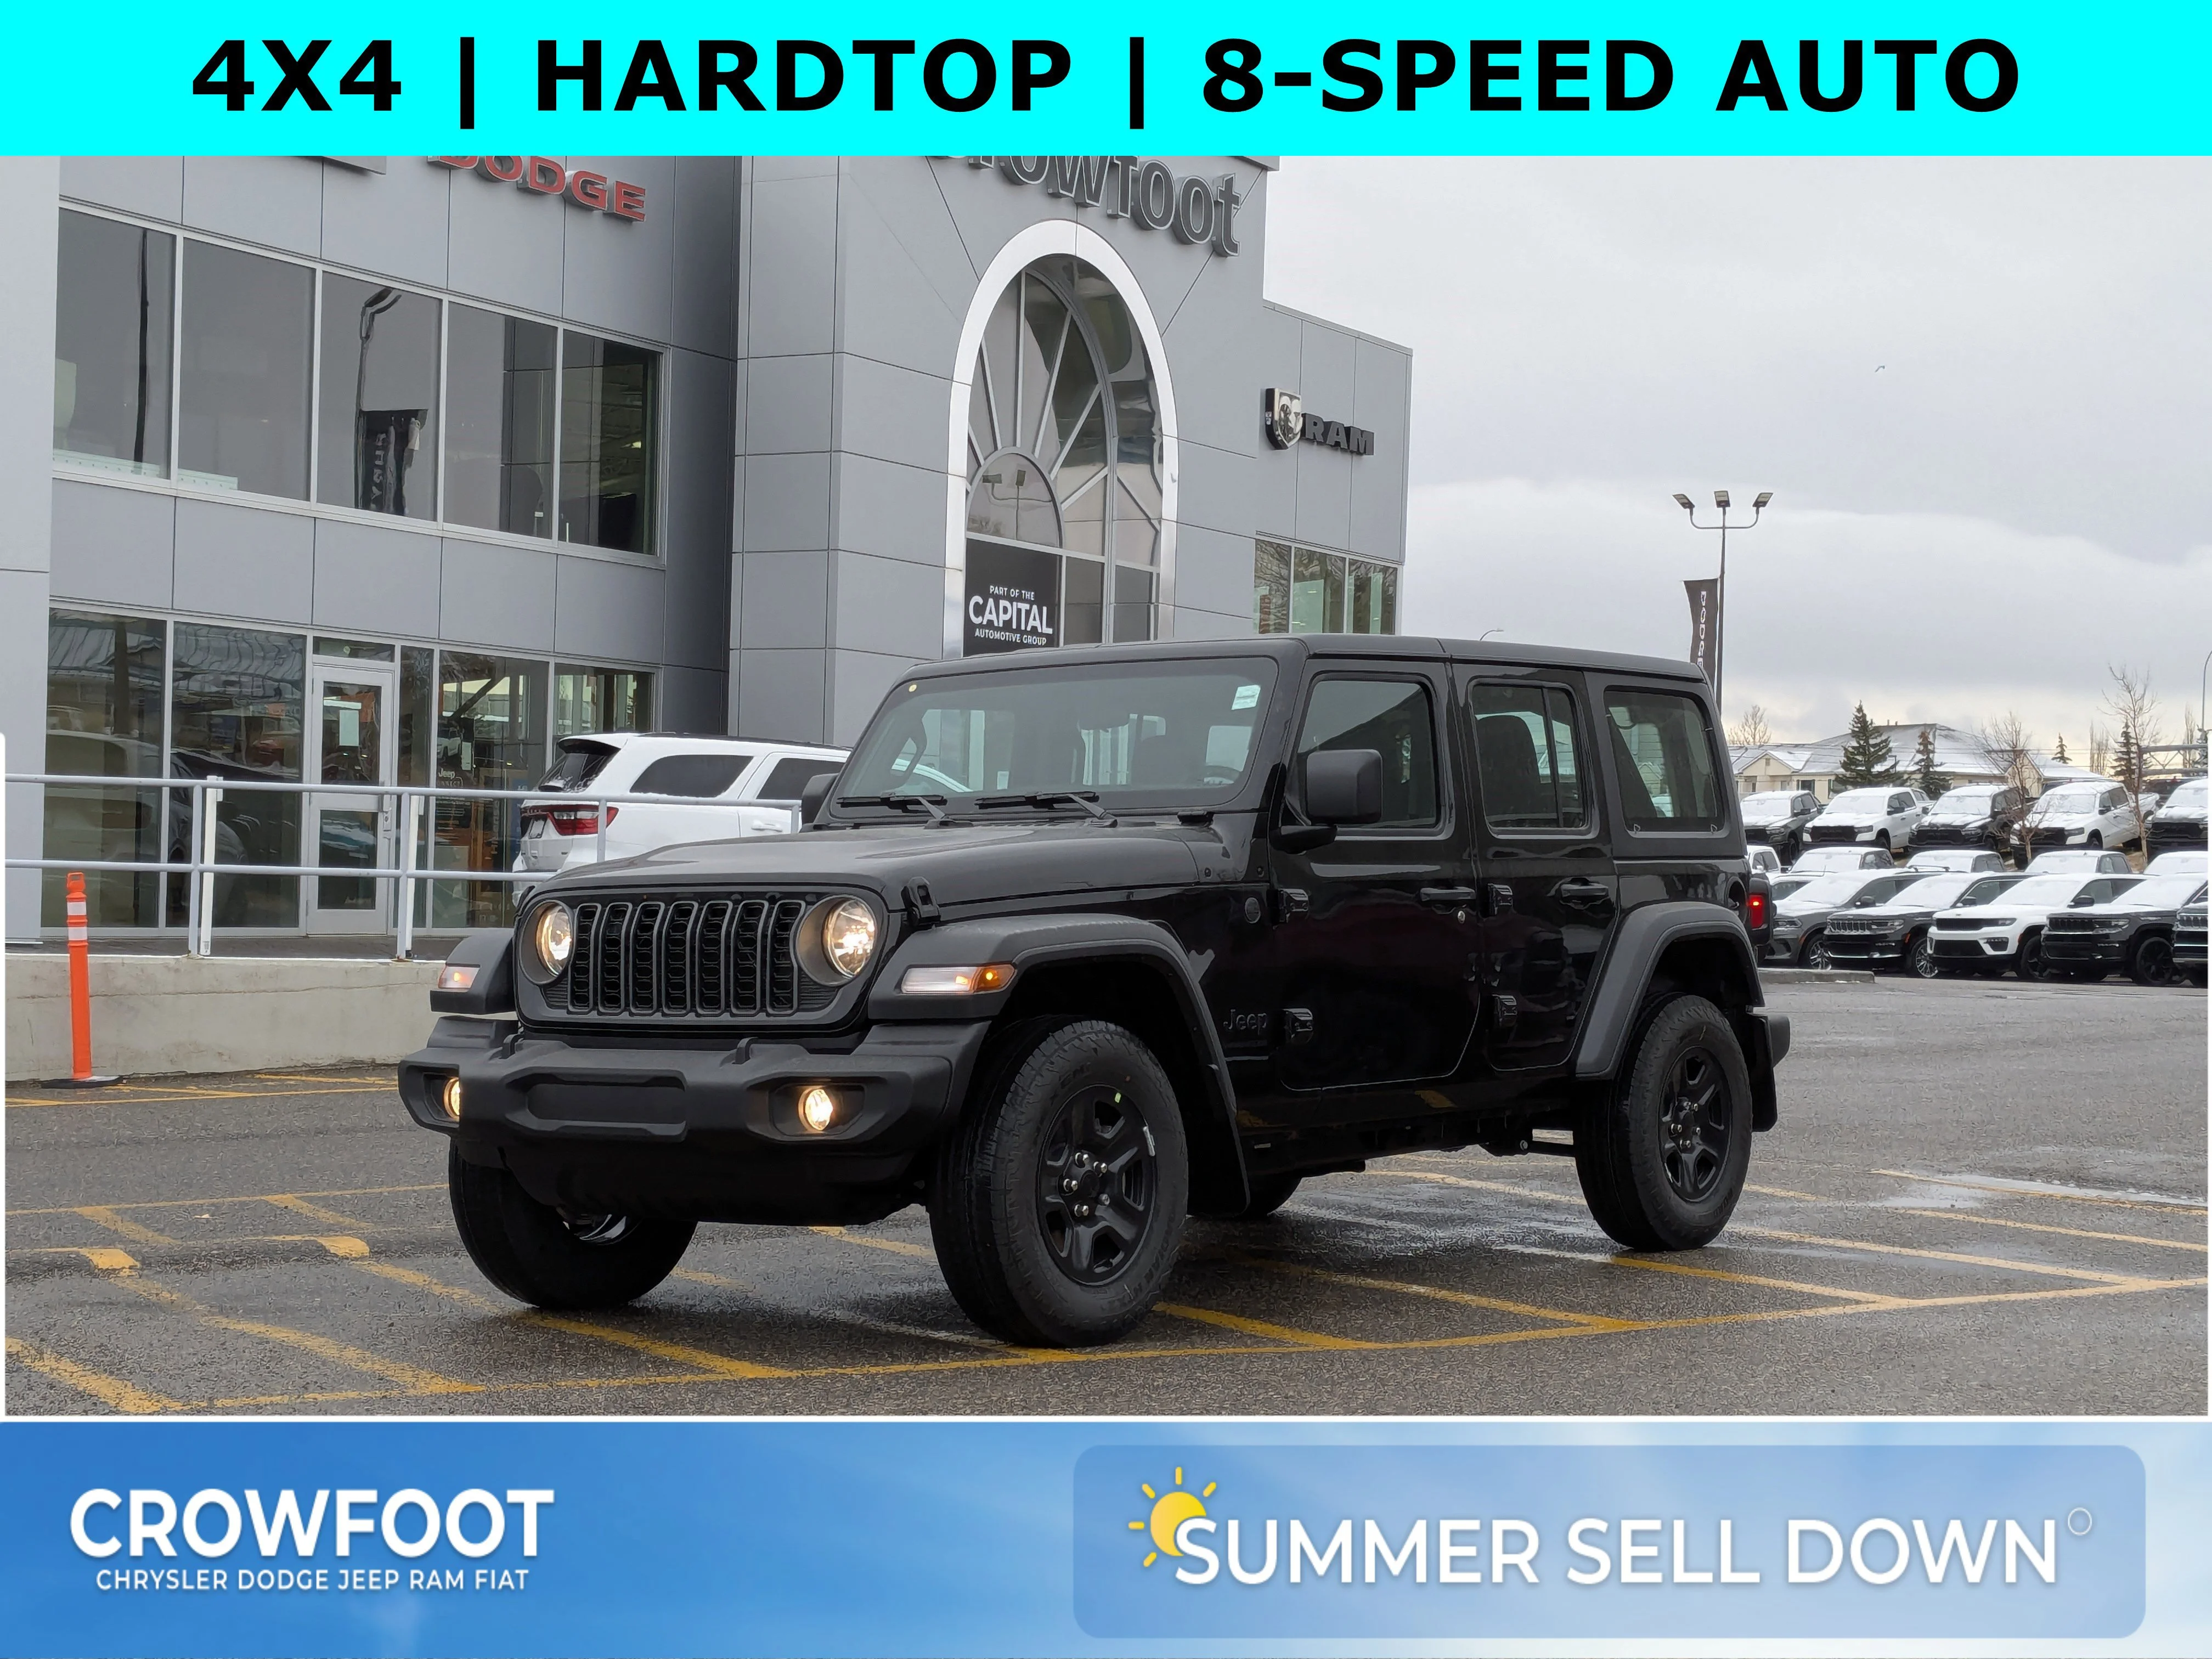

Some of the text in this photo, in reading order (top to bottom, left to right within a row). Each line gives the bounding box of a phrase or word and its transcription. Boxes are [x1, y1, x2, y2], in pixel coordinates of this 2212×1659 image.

[939, 156, 1240, 256] wfoot
[1302, 413, 1375, 456] RAM
[989, 585, 1035, 600] PART OF THE
[968, 595, 1053, 635] CAPITAL
[974, 628, 1047, 646] AUTOMOTIVE GROUP
[438, 768, 456, 780] Jeep
[1223, 1009, 1267, 1035] Jeep
